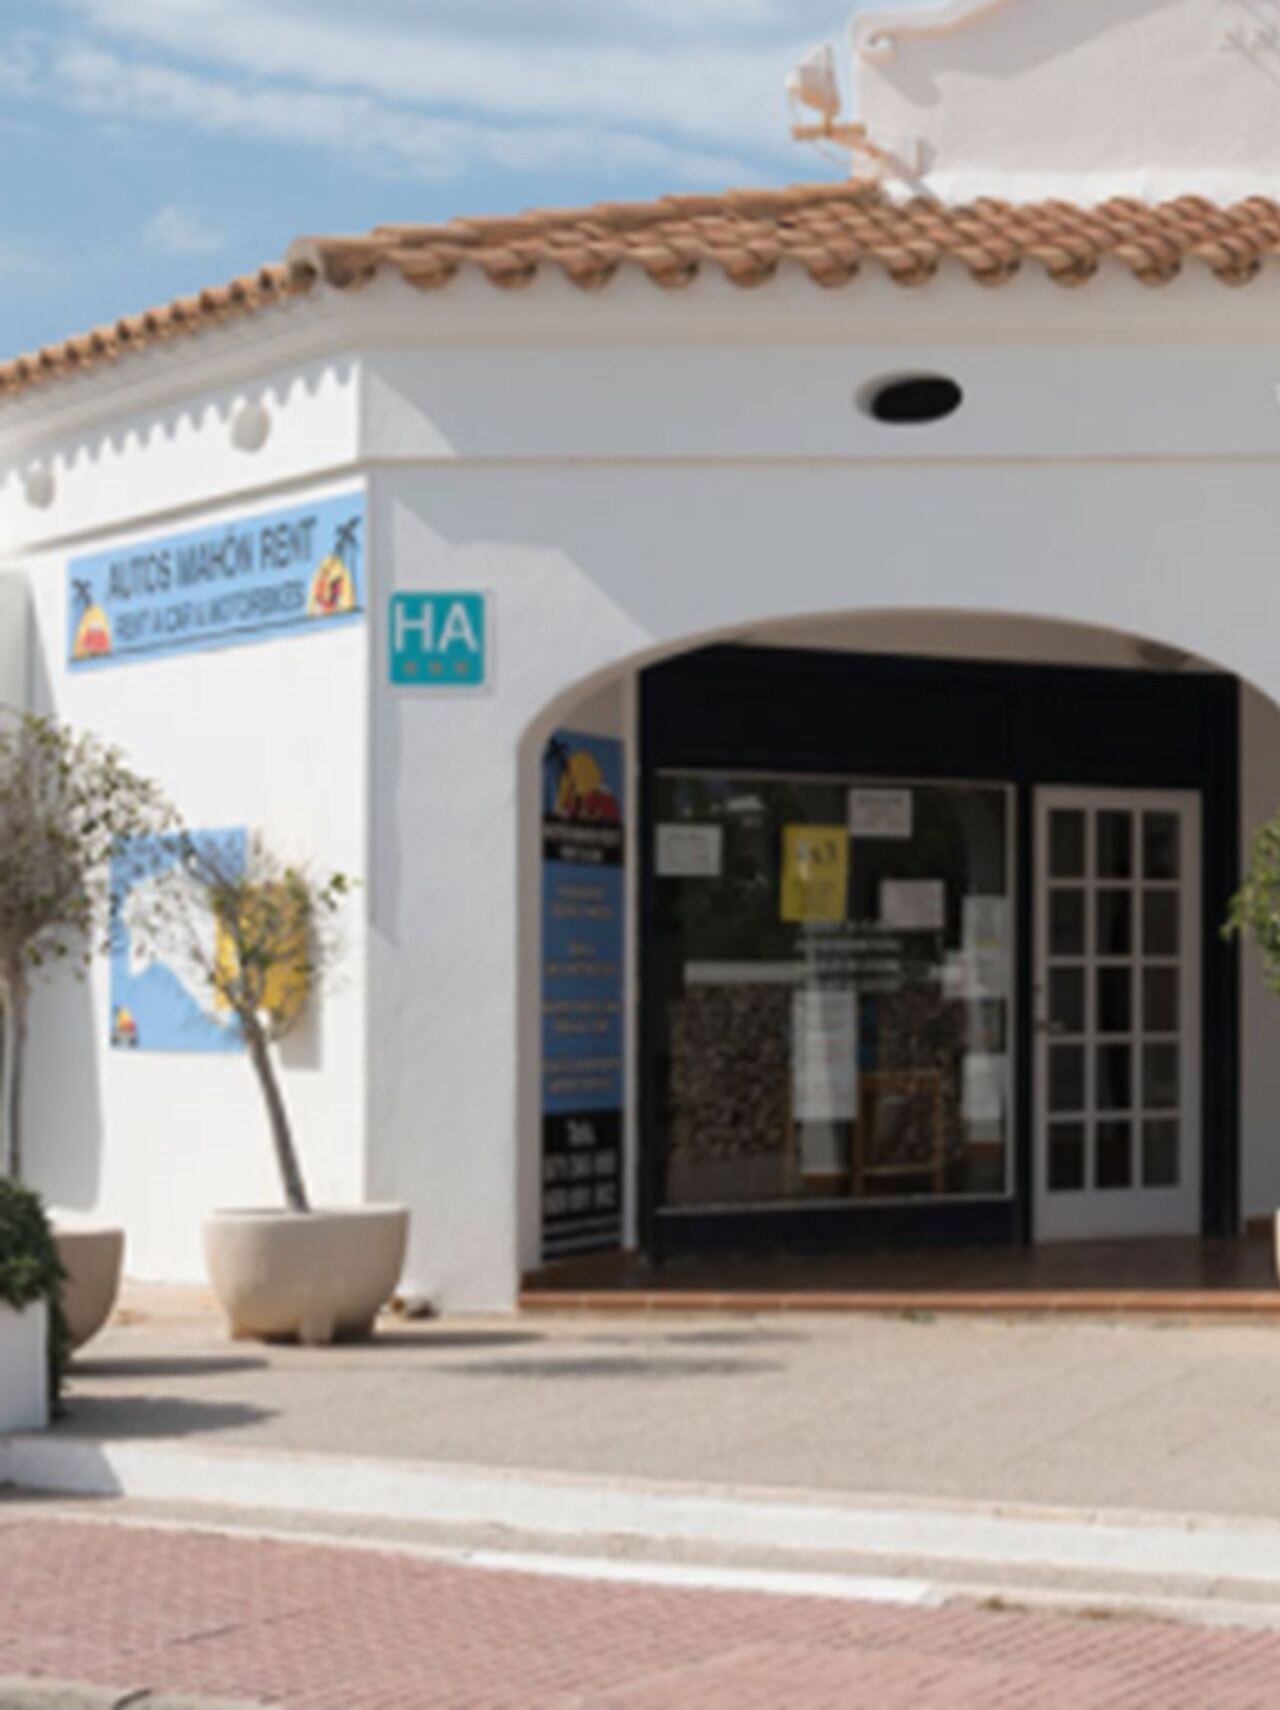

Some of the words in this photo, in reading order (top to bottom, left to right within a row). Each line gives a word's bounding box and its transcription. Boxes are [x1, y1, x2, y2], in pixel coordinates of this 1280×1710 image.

[107, 549, 171, 599] AUTOS
[260, 516, 318, 571] RENT
[395, 601, 478, 653] HA
